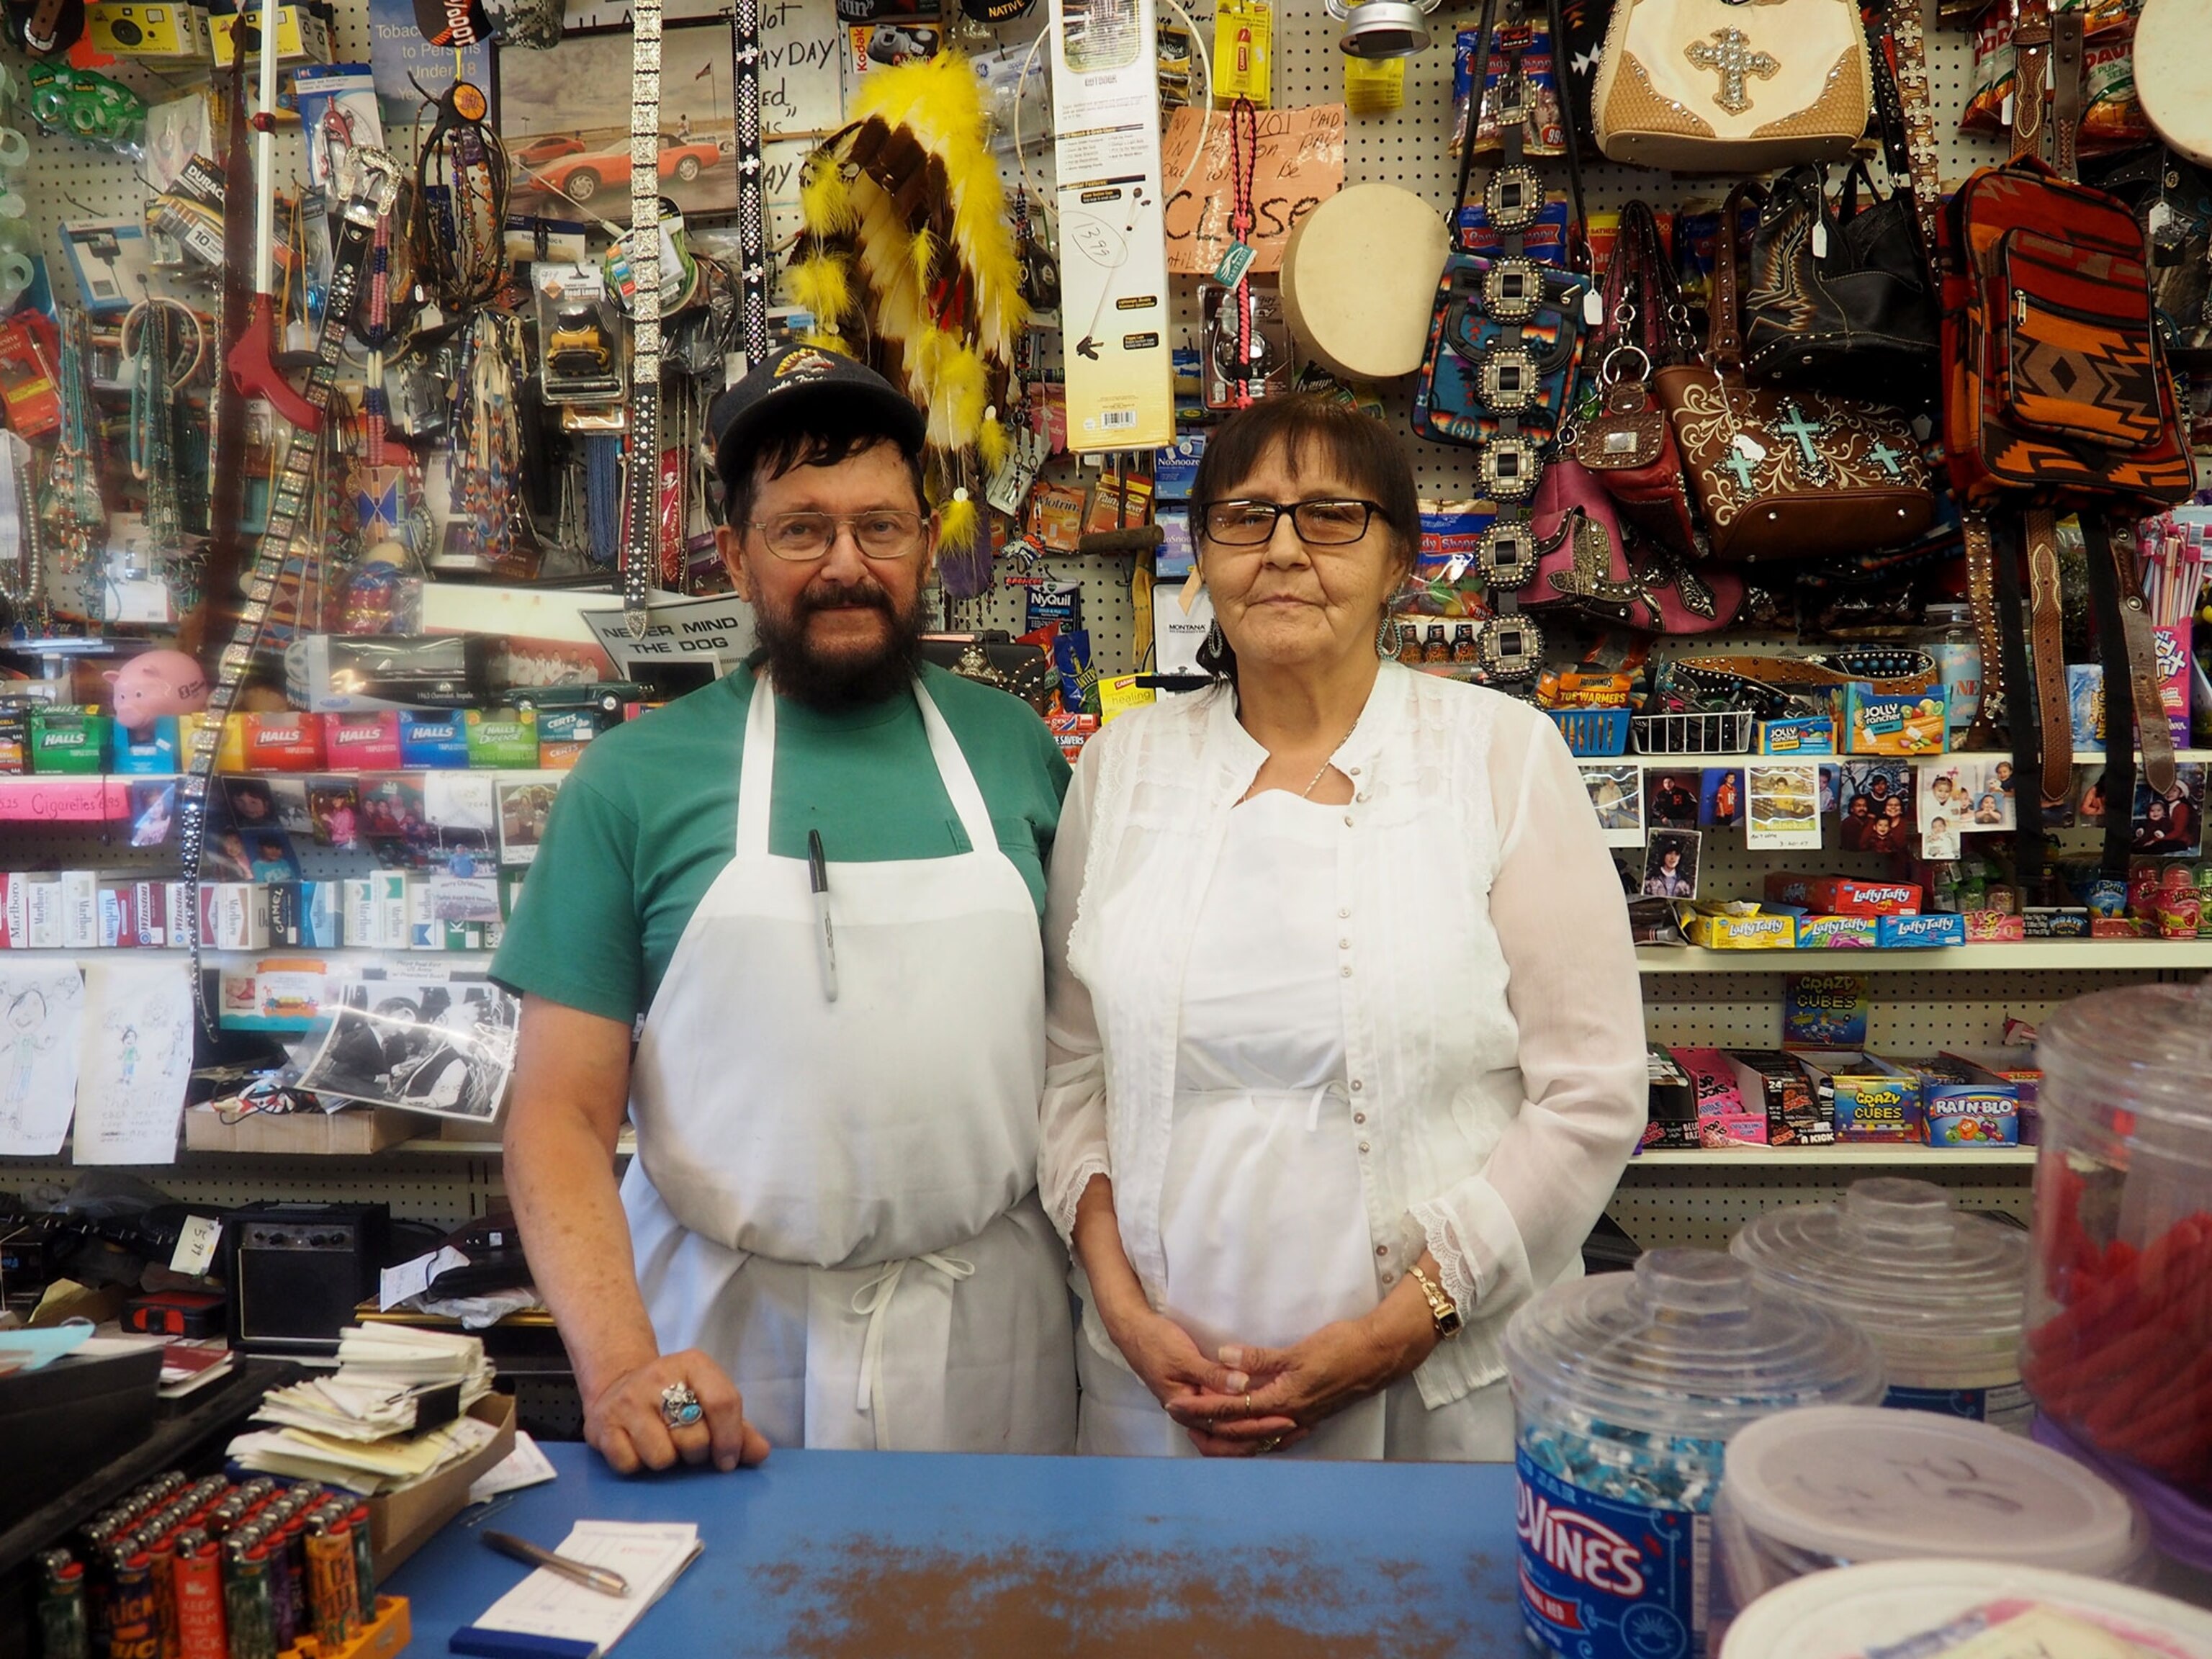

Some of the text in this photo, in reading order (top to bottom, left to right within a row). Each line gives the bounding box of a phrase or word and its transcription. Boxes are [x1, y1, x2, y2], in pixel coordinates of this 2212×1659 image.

[989, 0, 1025, 17] NATIVE
[376, 24, 423, 38] Tobac
[403, 43, 481, 58] to Persns
[854, 28, 868, 71] Kodak
[2085, 45, 2132, 68] DAVI
[1489, 58, 1511, 71] ndy
[1309, 108, 1340, 128] PAID
[1277, 157, 1302, 179] Be
[187, 164, 225, 203] DURAC
[763, 162, 792, 194] AY
[194, 229, 211, 247] 10
[1469, 228, 1554, 243] Cand oppe
[1158, 457, 1200, 467] NoSnooze
[1037, 494, 1077, 512] Motrin
[1097, 491, 1117, 505] Pain
[1442, 539, 1477, 549] Shopp
[1031, 593, 1071, 607] NyQuil
[602, 616, 738, 639] NEER MIND
[629, 637, 729, 654] THE DOG
[1116, 677, 1136, 688] CARME
[1112, 690, 1151, 705] healing
[1560, 692, 1626, 703] TOE WARMERS
[1863, 703, 1898, 719] JOLLY
[1866, 713, 1901, 724] rancher
[547, 714, 577, 729] CERTS
[259, 729, 301, 743] HALLS
[339, 728, 381, 743] HALLS
[411, 727, 454, 739] HALLS
[487, 725, 516, 735] HALLS
[1771, 727, 1797, 738] JOLLY
[44, 733, 86, 746] HALLS
[1771, 734, 1799, 742] rancher
[549, 744, 578, 757] CERTS
[32, 793, 95, 819] Cigarettes
[11, 881, 20, 938] Marlboro
[34, 886, 44, 925] Marlboro
[271, 887, 284, 934] CAMEL
[78, 900, 92, 940] Marlboro
[106, 897, 119, 940] Marlboro
[229, 898, 241, 936] Marlboro
[391, 905, 404, 938] Marlboro
[1797, 996, 1856, 1010] CUBES
[1699, 1074, 1715, 1088] OP
[1768, 1081, 1783, 1089] 24
[1854, 1107, 1903, 1119] CUBES
[1684, 1131, 1700, 1141] RAZ
[1809, 1133, 1835, 1143] KICK
